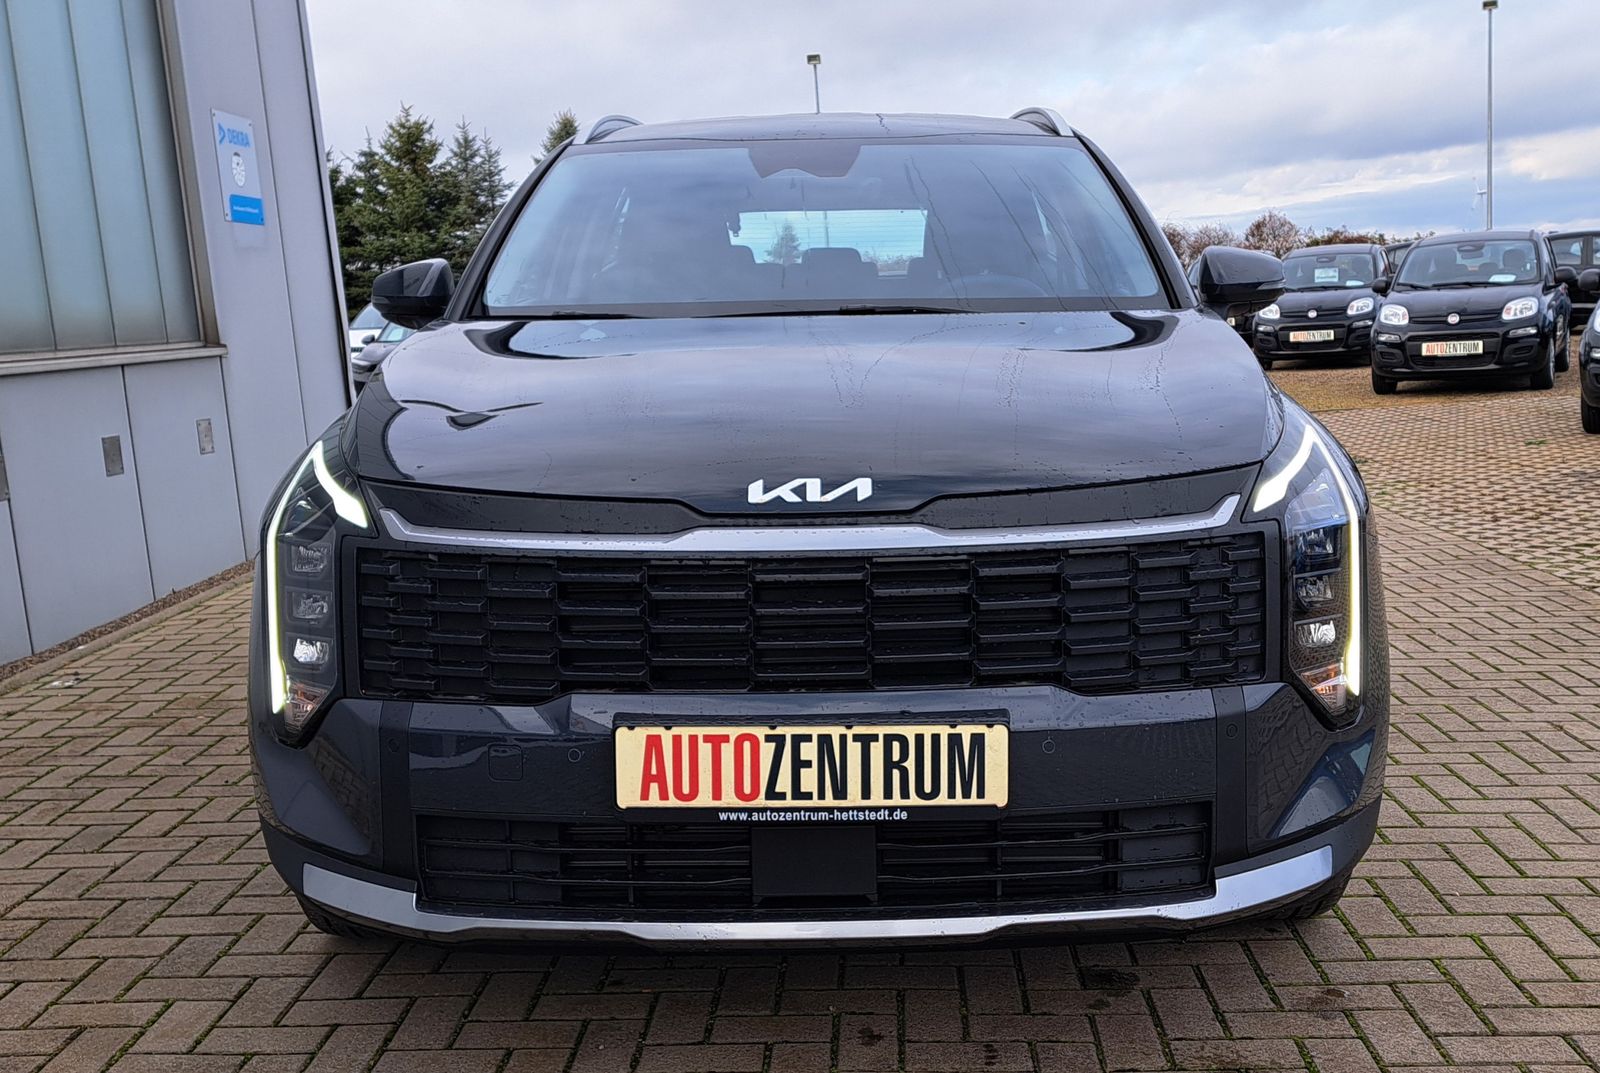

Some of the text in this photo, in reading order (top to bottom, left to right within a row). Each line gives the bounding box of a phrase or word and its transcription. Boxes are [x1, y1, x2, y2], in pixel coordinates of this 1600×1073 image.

[227, 128, 250, 148] DEKRA
[1425, 342, 1480, 354] AUTOZENTRUM
[748, 477, 872, 503] KIA
[639, 732, 986, 802] AUTOZENTRUM
[718, 810, 908, 822] www.autozentrum-hettstedt.de
